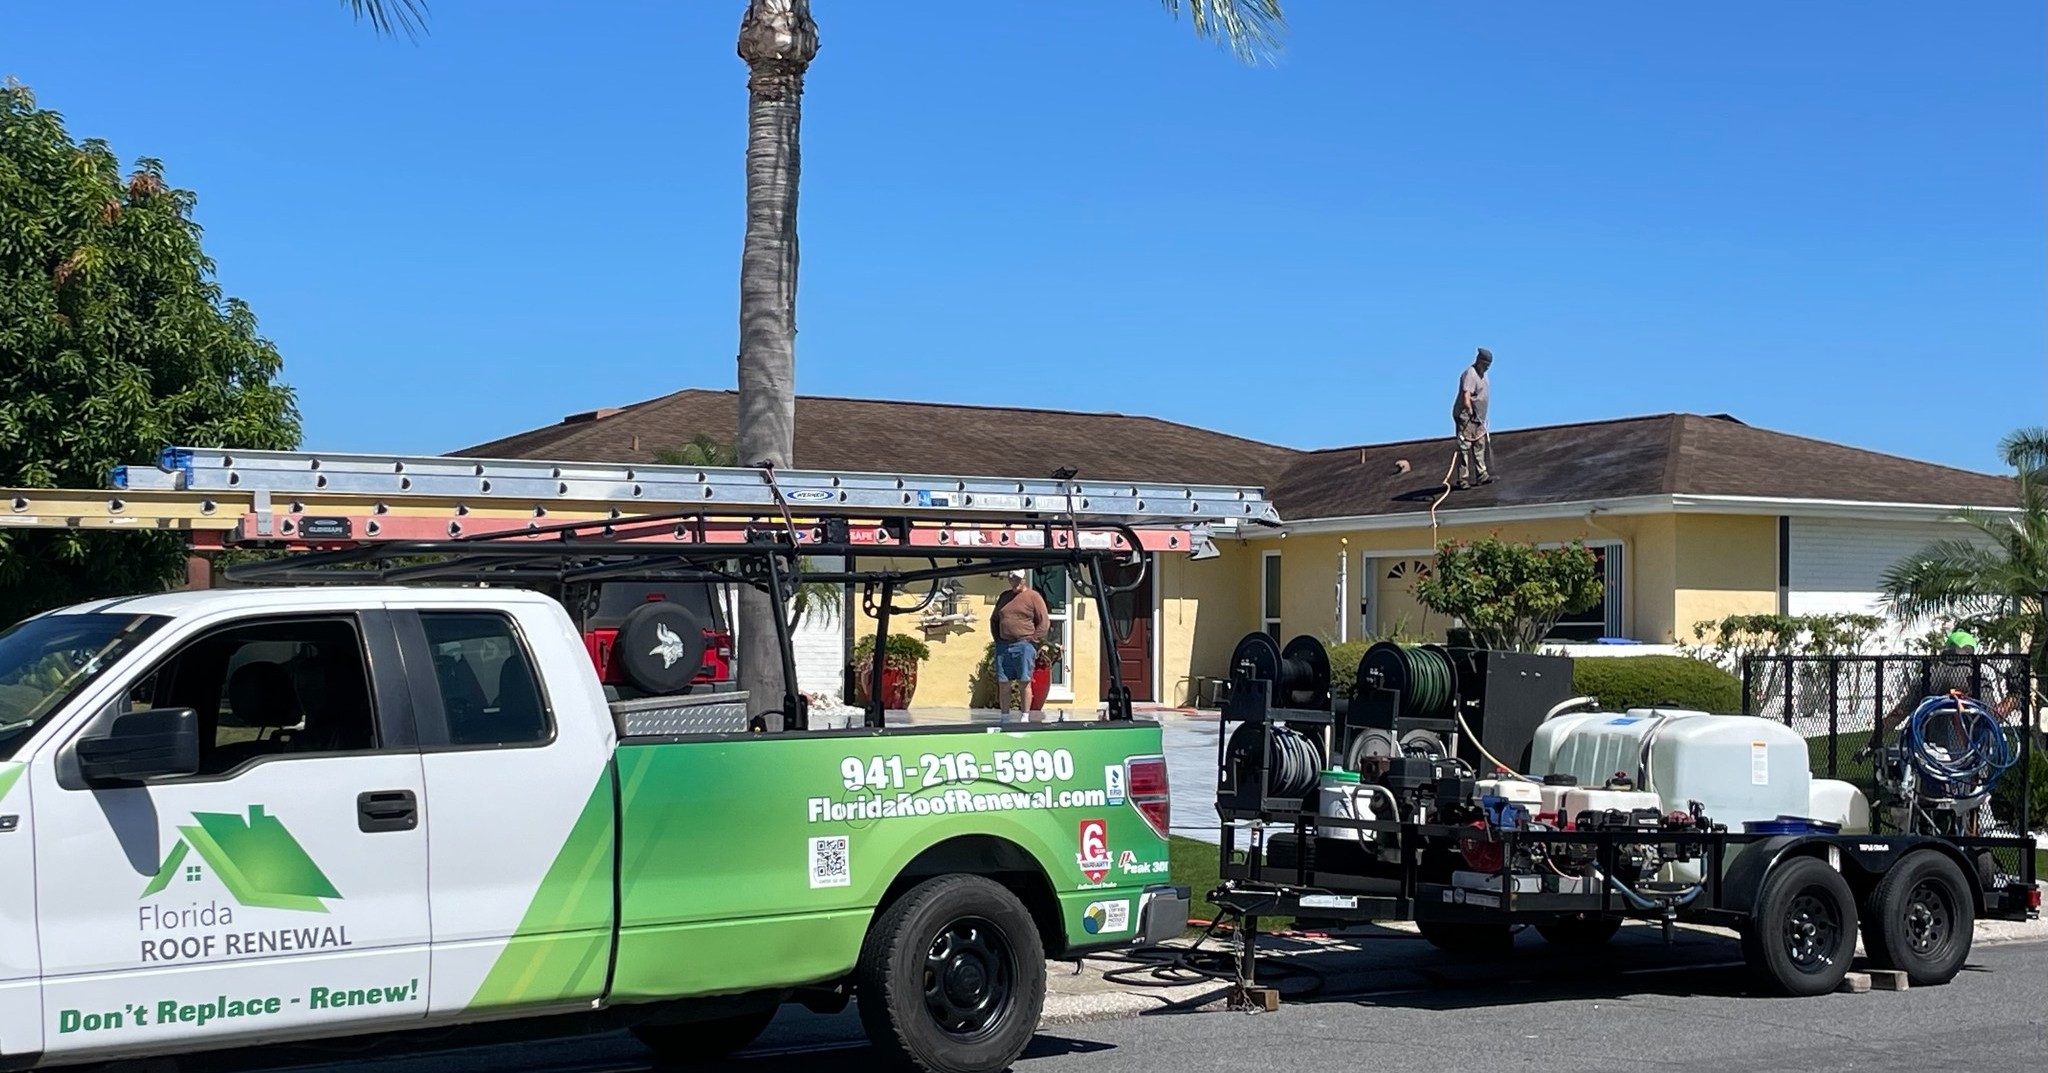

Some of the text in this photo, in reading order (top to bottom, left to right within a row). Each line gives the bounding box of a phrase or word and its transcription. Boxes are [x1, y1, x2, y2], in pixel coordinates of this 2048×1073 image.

[841, 748, 1074, 791] 941-216-5990
[808, 785, 1106, 823] FloridaRoofRenewal.com
[1083, 823, 1104, 861] 6
[1123, 862, 1151, 875] Peak
[139, 901, 233, 931] Florida
[141, 925, 353, 962] ROOF RENEWAL
[59, 1003, 148, 1034] Don't
[157, 995, 281, 1026] Replace
[310, 979, 419, 1009] Renew!
